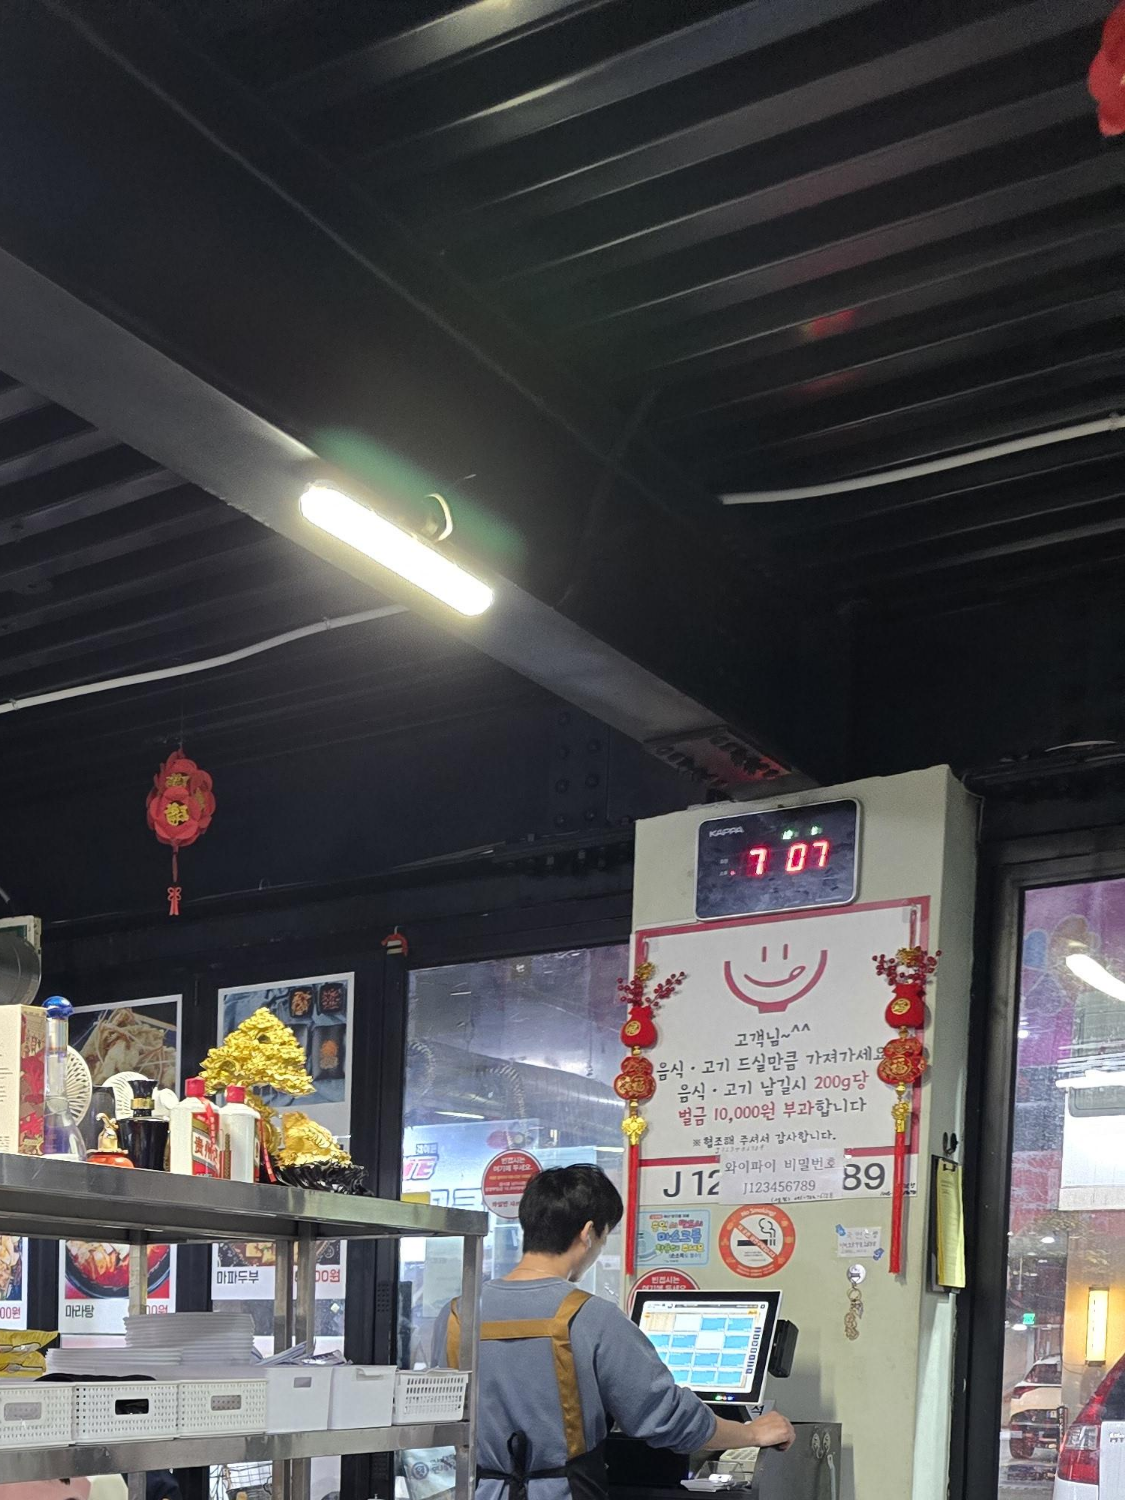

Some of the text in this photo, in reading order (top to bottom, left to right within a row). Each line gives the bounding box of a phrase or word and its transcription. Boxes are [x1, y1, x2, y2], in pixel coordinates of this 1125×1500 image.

[656, 1046, 886, 1081] 음식 고기 드실만큼 가져가세요
[677, 1070, 870, 1103] 음식 고기 남길시 200g당
[678, 1097, 867, 1127] 벌금 10,000원 부과합니다
[739, 1134, 770, 1146] 주셔서
[775, 1130, 837, 1143] 감사합니다.
[725, 1156, 836, 1175] 와이파이 비밀번호
[742, 1179, 816, 1195] J123456789
[216, 1270, 259, 1284] 마파두부
[65, 1304, 94, 1318] 마라탕
